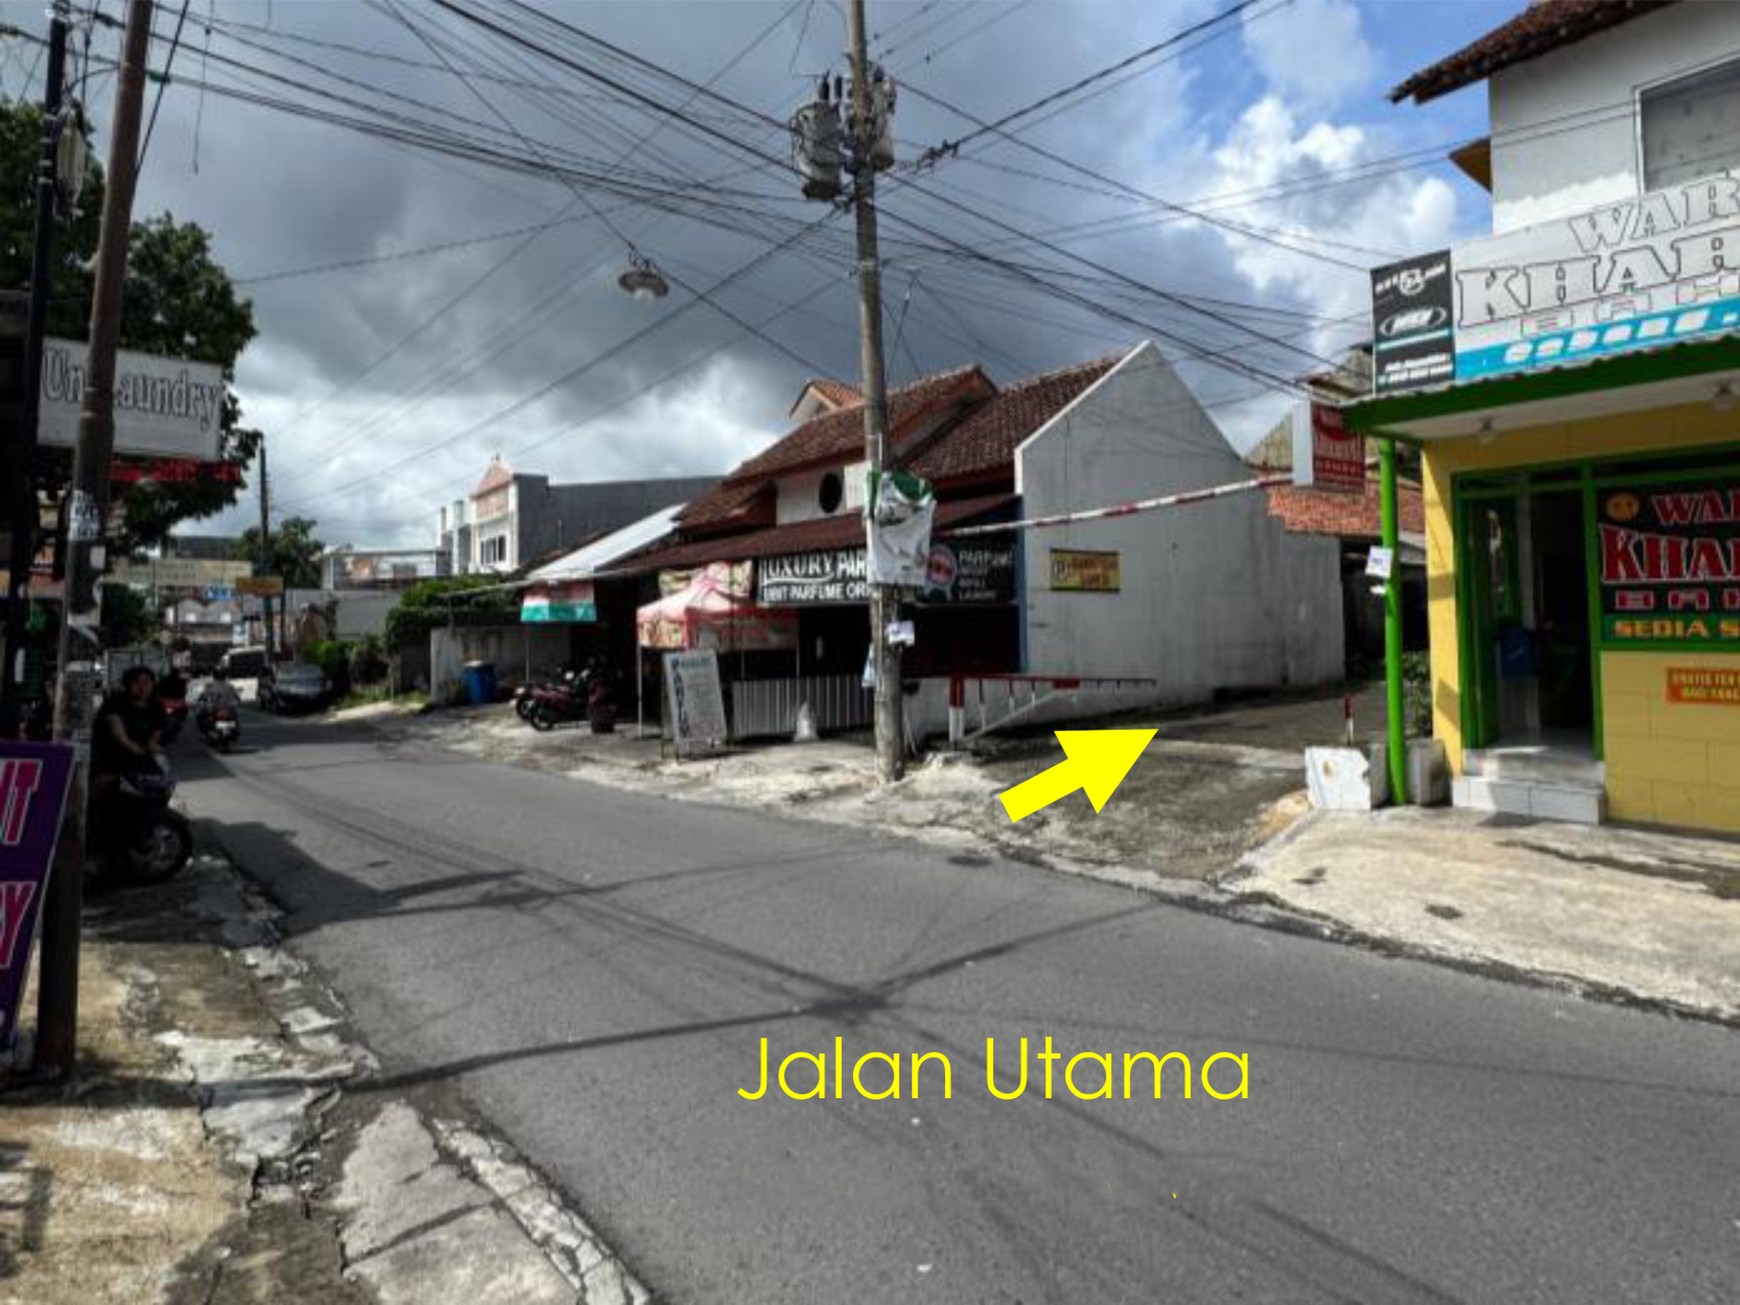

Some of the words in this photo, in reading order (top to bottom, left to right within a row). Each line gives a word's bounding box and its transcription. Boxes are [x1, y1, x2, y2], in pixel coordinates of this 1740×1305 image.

[42, 347, 90, 402] Un
[115, 368, 219, 431] aundry
[759, 552, 835, 587] LUXURY
[836, 548, 868, 579] PAR
[1611, 618, 1710, 640] SEDIA
